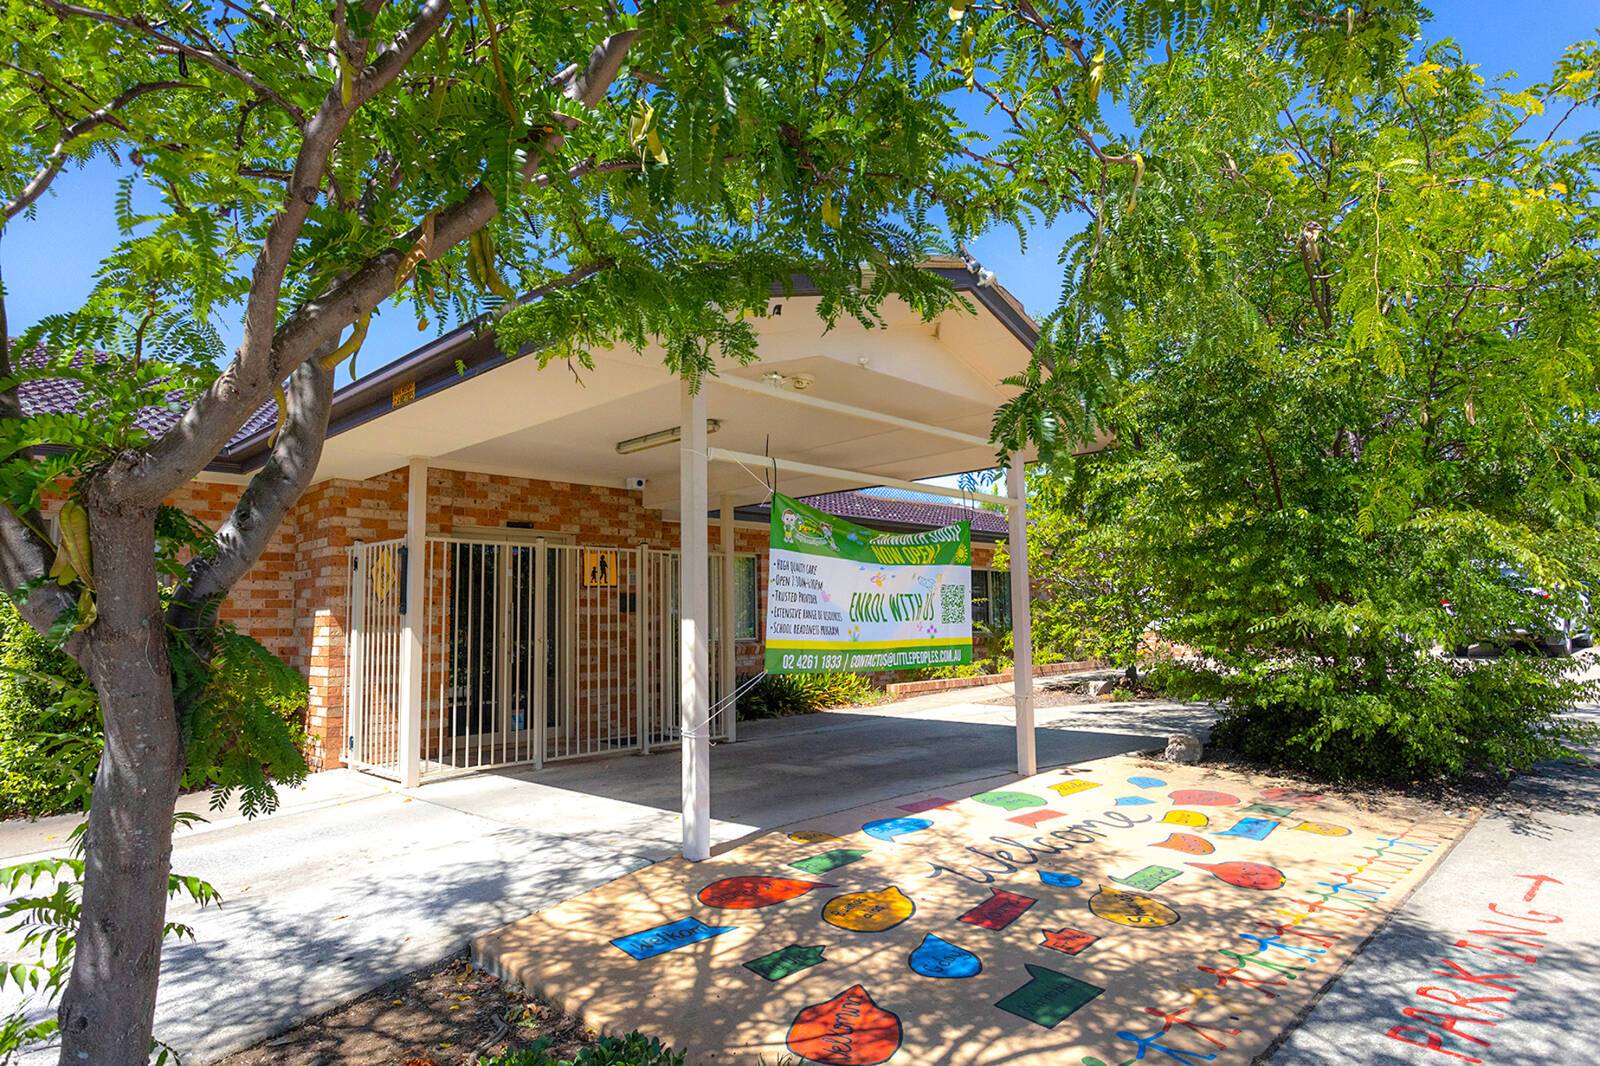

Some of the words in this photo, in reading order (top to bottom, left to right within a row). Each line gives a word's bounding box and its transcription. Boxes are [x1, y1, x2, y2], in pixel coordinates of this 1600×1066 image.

[871, 545, 906, 565] NOW
[901, 544, 941, 565] OPEN!
[776, 559, 790, 572] HIGH
[790, 561, 806, 575] QUALITY
[806, 564, 818, 576] CARE
[775, 574, 791, 587] OPEN
[775, 590, 798, 603] TRUSTED
[773, 606, 802, 620] EXTENSIVE
[802, 609, 818, 620] RANGE
[849, 592, 888, 623] ENROL
[889, 593, 923, 622] WITH
[923, 591, 936, 621] US
[773, 622, 792, 634] SCHOOL
[793, 623, 819, 636] READINESS
[820, 625, 840, 637] PROGRAM
[783, 654, 794, 669] 02
[796, 655, 818, 669] 4261
[821, 654, 842, 669] 1833
[925, 811, 1152, 884] Welcome
[630, 924, 709, 951] Welkom
[1385, 902, 1564, 1065] PARKING
